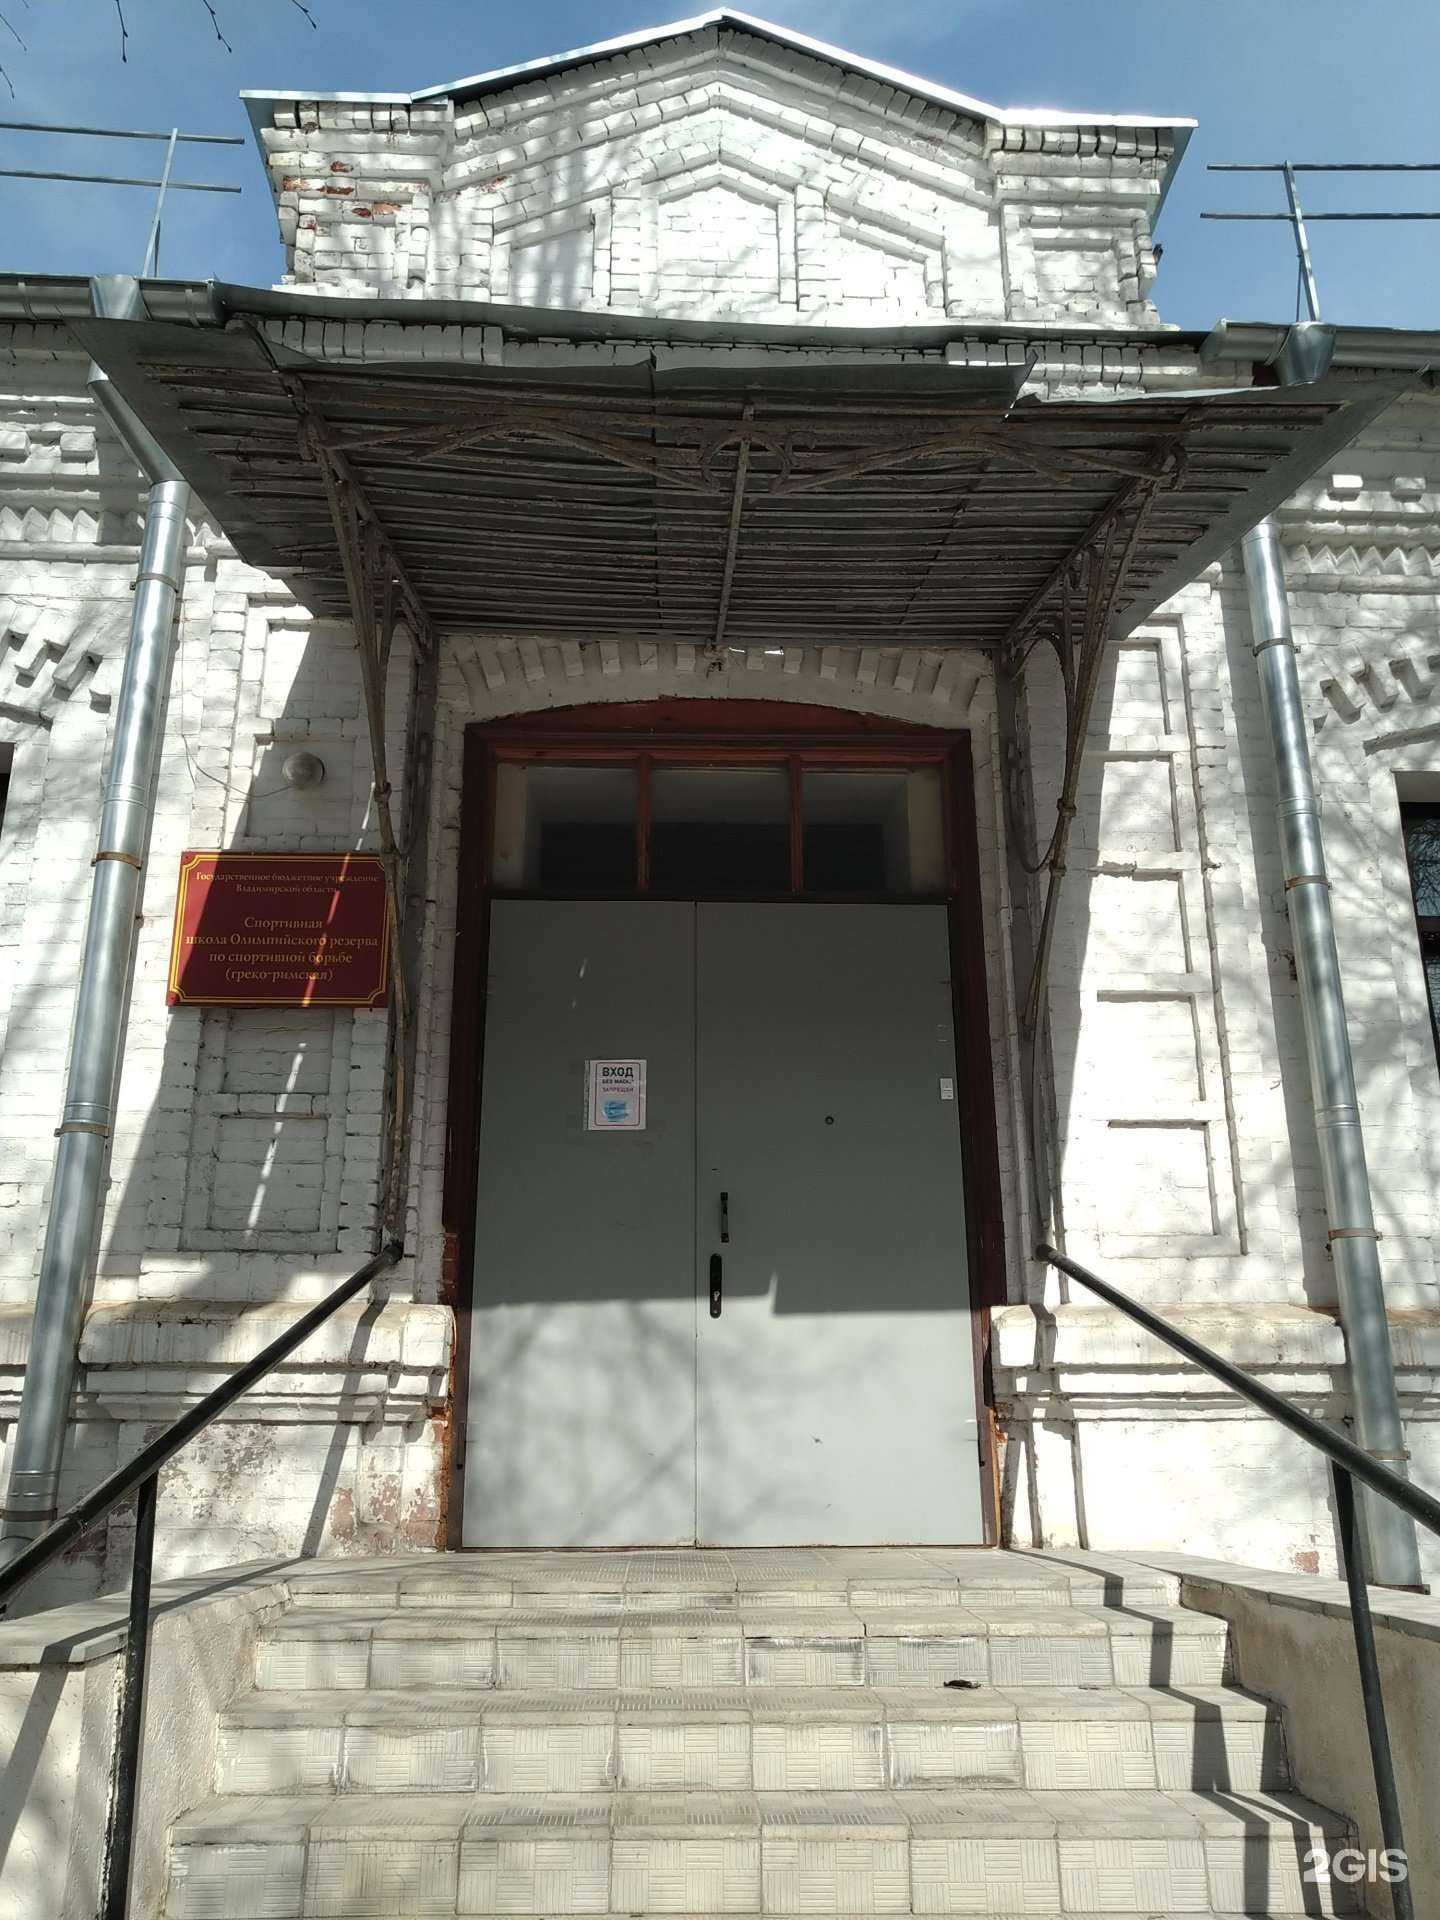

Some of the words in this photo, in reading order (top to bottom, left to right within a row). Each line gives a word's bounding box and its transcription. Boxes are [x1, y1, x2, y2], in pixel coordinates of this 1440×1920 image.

[196, 872, 270, 882] Государственное
[271, 872, 323, 882] бюджетное
[236, 884, 300, 894] Владимирской
[302, 884, 338, 893] области
[244, 916, 322, 931] Спортивная
[185, 936, 227, 945] школа
[230, 933, 327, 946] Олимпийского
[329, 938, 378, 949] резерва
[209, 953, 226, 962] по
[228, 952, 305, 965] спортивной
[308, 951, 353, 966] борьбе
[225, 968, 333, 983] (греко-римская)
[602, 1067, 634, 1078] ВХОД
